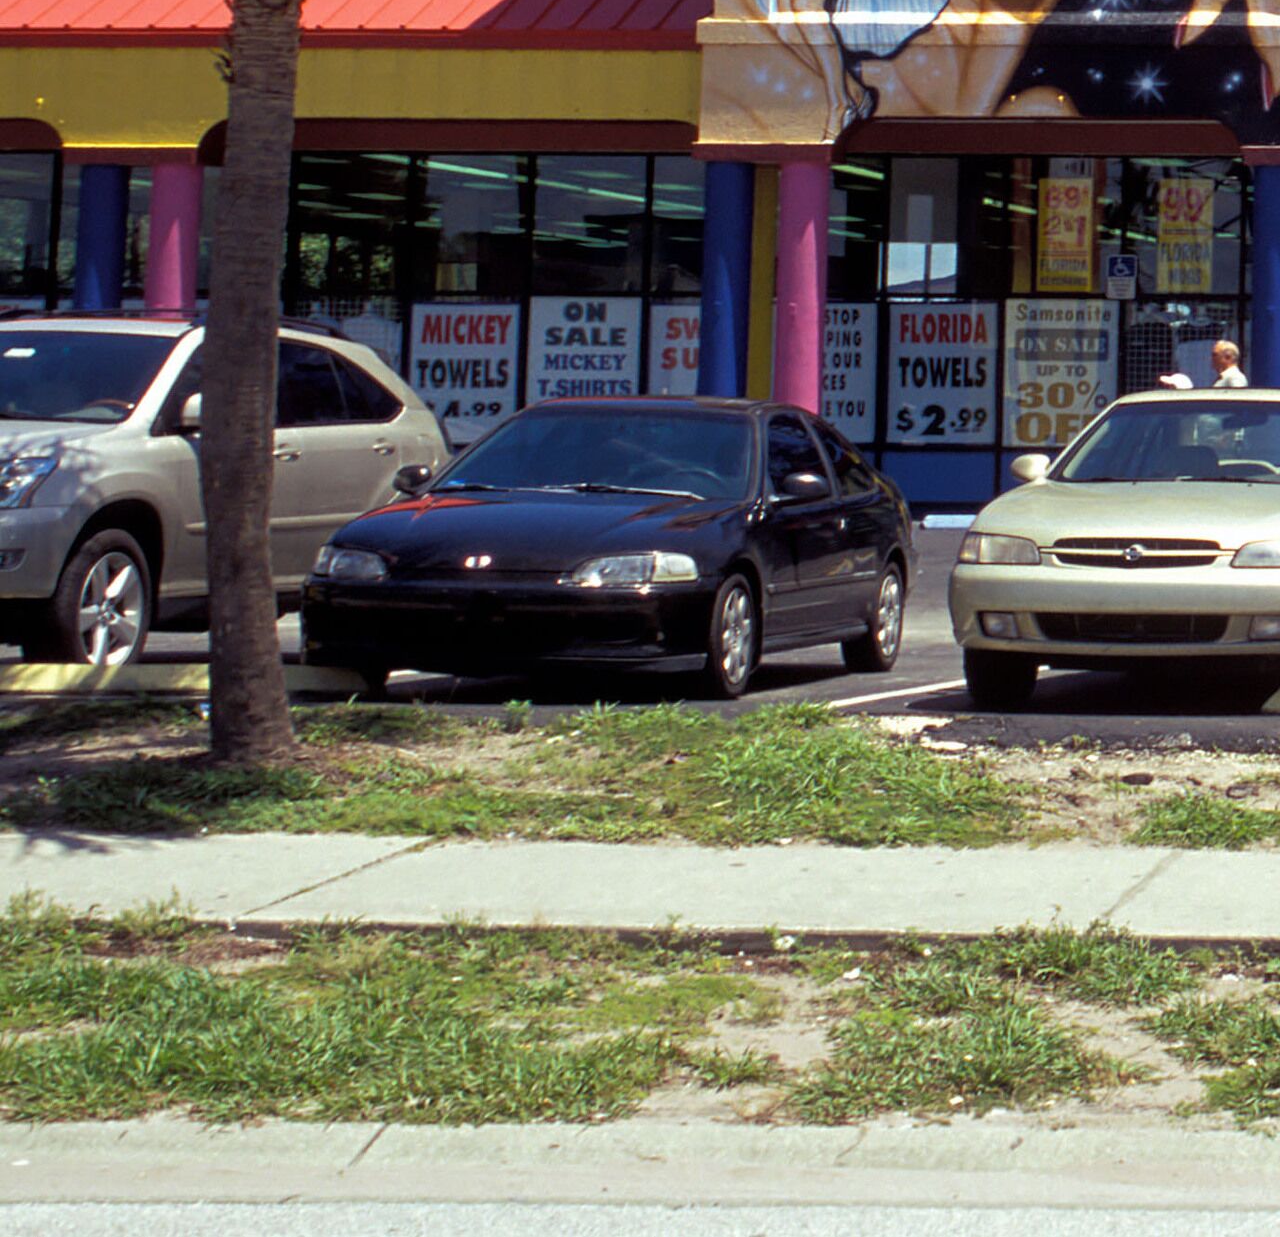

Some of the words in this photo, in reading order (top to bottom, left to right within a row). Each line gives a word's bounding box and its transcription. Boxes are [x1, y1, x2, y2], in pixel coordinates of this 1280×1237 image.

[563, 301, 608, 322] ON
[824, 309, 860, 324] STOP
[1016, 304, 1112, 321] Samsonite
[421, 314, 512, 345] MICKEY
[544, 327, 627, 347] SALE
[899, 313, 988, 344] FLORIDA
[1018, 336, 1047, 352] ON
[1055, 335, 1108, 352] SALE
[543, 353, 627, 371] MICKEY
[832, 352, 862, 368] OUR
[415, 358, 509, 389] TOWELS
[898, 357, 987, 389] TOWELS
[1036, 365, 1061, 377] UP
[1065, 364, 1088, 377] TO
[1017, 381, 1108, 410] 30%
[838, 400, 866, 417] YOU
